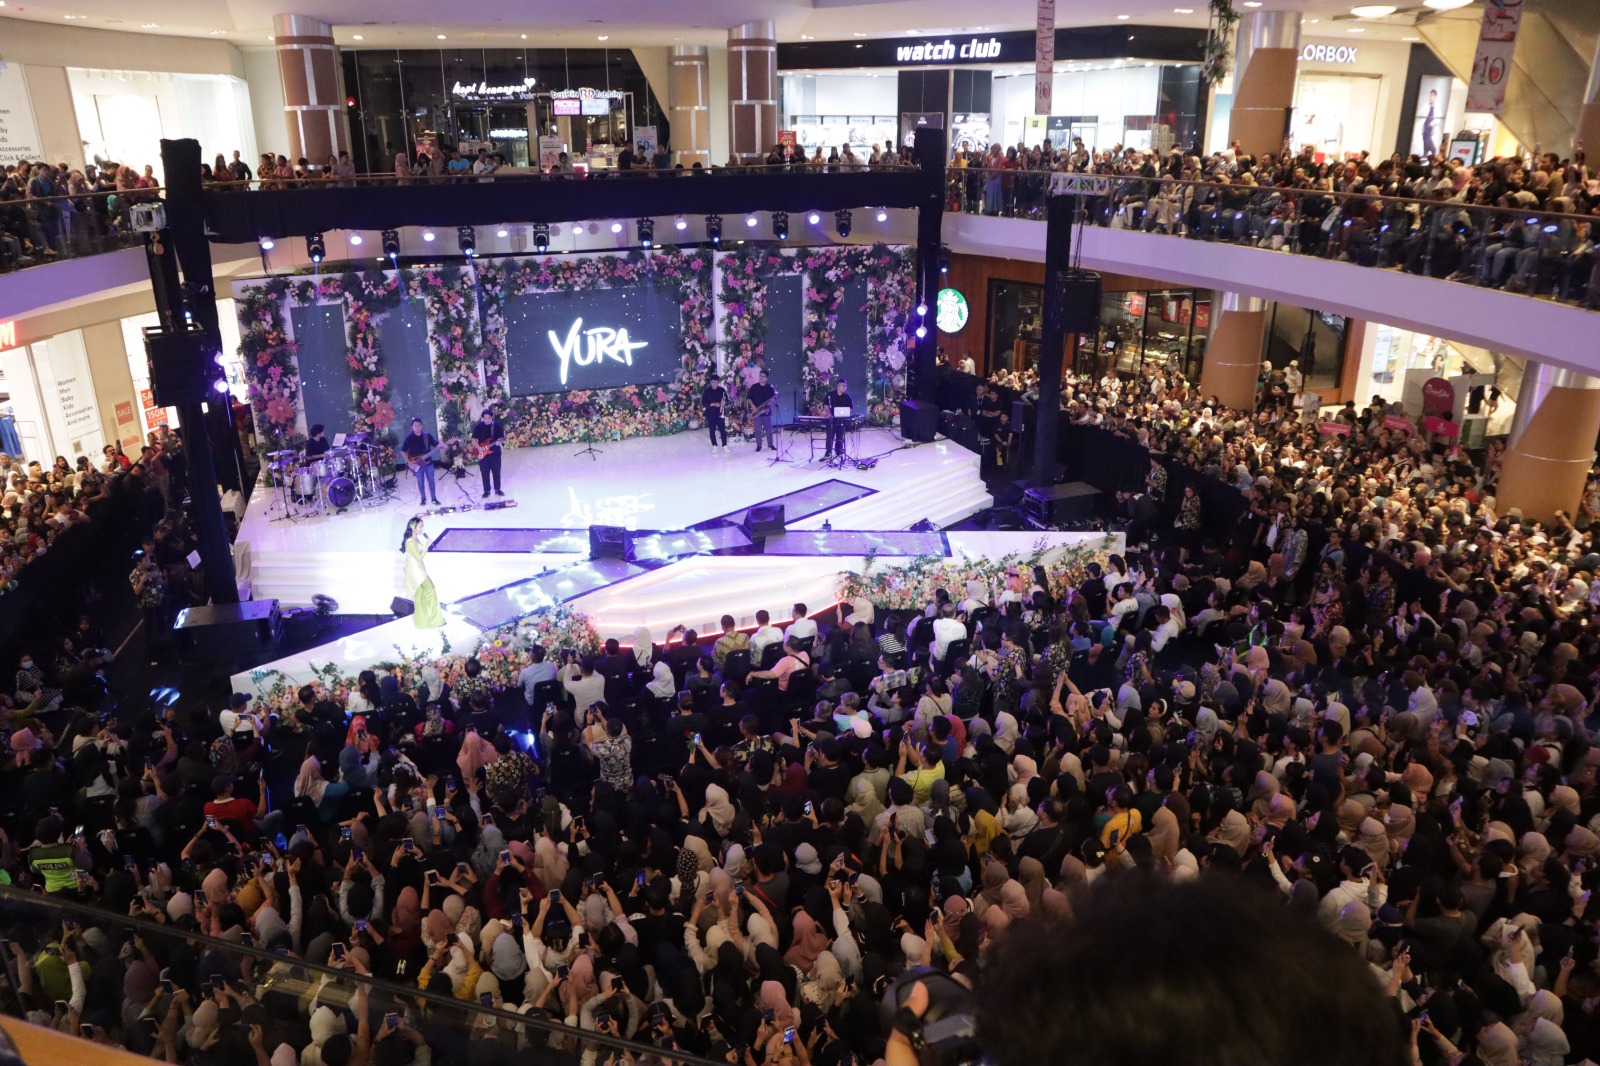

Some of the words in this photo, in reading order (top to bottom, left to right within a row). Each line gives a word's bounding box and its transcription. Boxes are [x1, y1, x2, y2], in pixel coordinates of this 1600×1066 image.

[897, 40, 954, 61] watch
[960, 38, 1001, 58] club
[1477, 56, 1505, 85] 10
[452, 81, 476, 94] kopi
[478, 82, 527, 95] kenangan
[550, 90, 579, 99] baskin
[548, 317, 649, 385] YURA
[57, 377, 76, 387] Women
[141, 391, 153, 401] SA
[65, 405, 93, 418] Accessories
[117, 406, 132, 417] SALE
[147, 406, 166, 419] 150K
[67, 418, 78, 426] And
[78, 414, 91, 422] more
